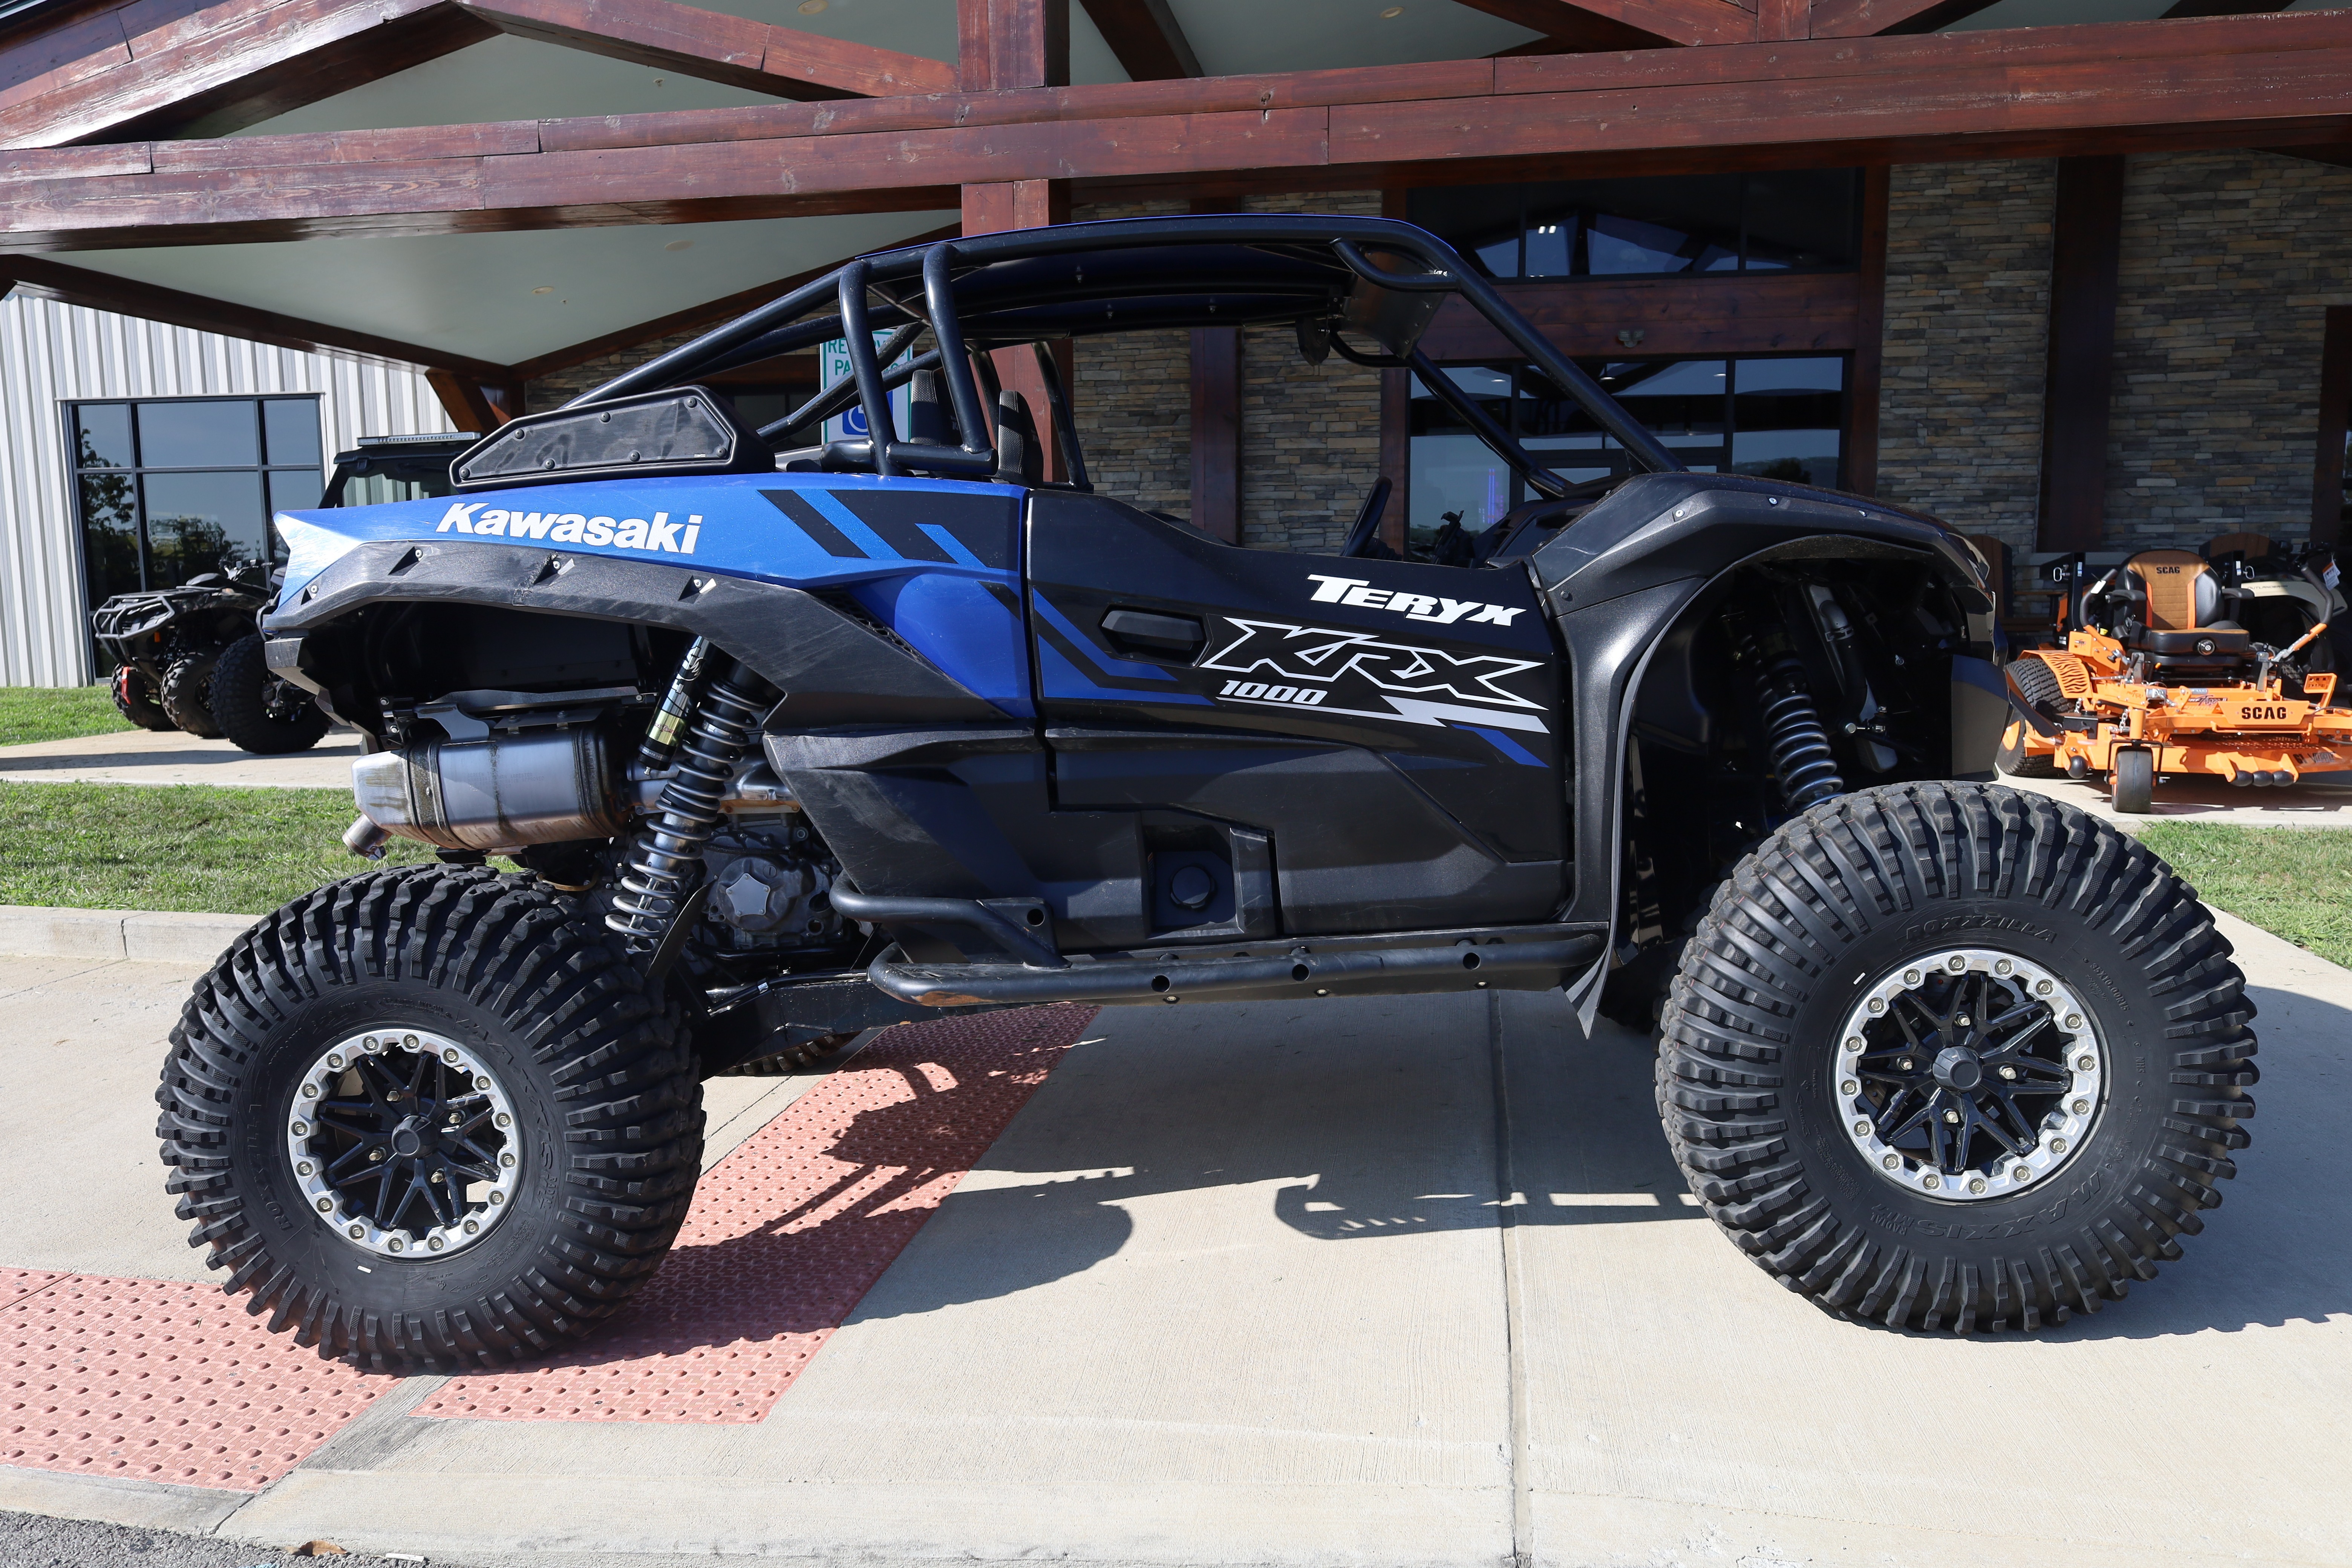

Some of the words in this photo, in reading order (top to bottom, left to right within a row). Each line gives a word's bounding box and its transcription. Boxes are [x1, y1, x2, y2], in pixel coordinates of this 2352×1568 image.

[436, 502, 703, 554] Kawasaki
[1199, 616, 1549, 710] KRX
[1219, 679, 1328, 705] 1000
[2241, 707, 2286, 719] SCAG
[1906, 915, 2058, 943] ROXXZILLA
[2090, 963, 2130, 1011] 35X10.00R15
[2135, 1057, 2145, 1073] NHS
[1916, 1171, 2101, 1240] MAXXIS
[1870, 1212, 1908, 1236] RADIAL
